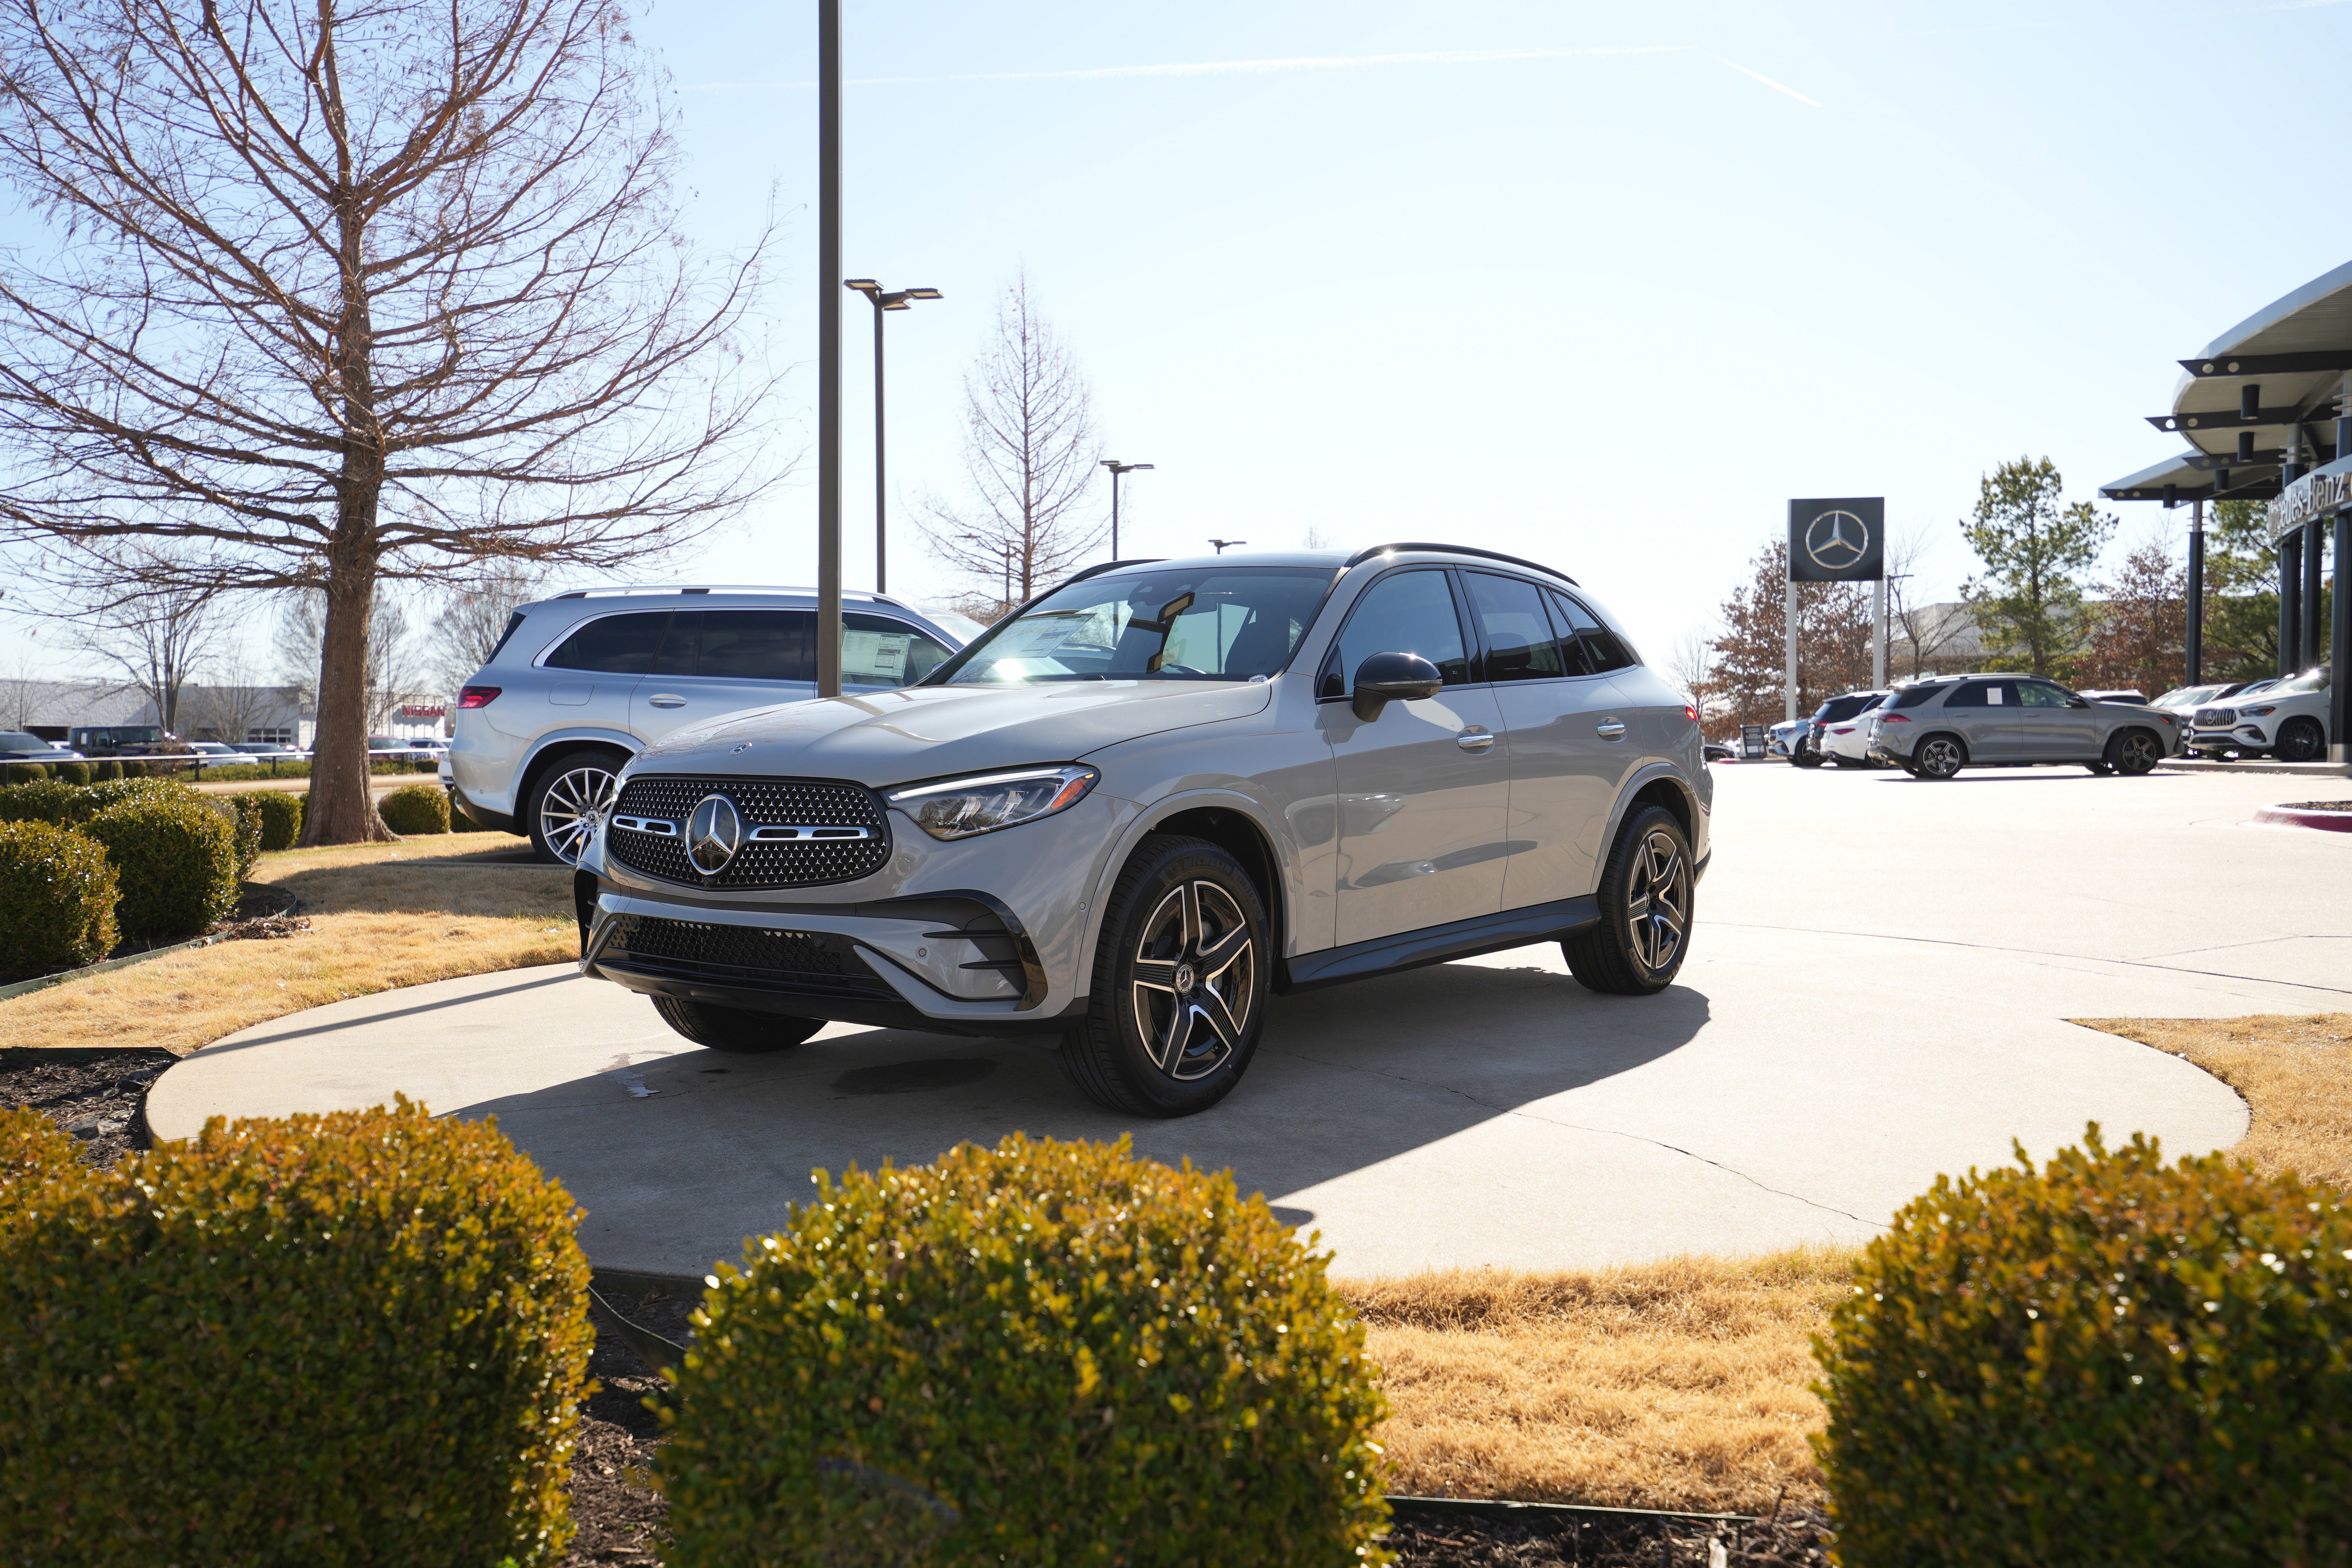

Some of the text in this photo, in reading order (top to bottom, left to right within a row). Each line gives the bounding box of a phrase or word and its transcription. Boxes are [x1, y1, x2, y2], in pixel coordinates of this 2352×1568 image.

[2268, 472, 2345, 532] cedes-Benz
[402, 705, 445, 717] NISSAN
[1183, 856, 1232, 873] MICHELIN
[1236, 875, 1253, 898] 235/55
[1256, 905, 1261, 914] 19
[1636, 964, 1646, 978] 255/50
[1648, 975, 1672, 987] MICHELIN
[1120, 997, 1131, 1037] SEASON
